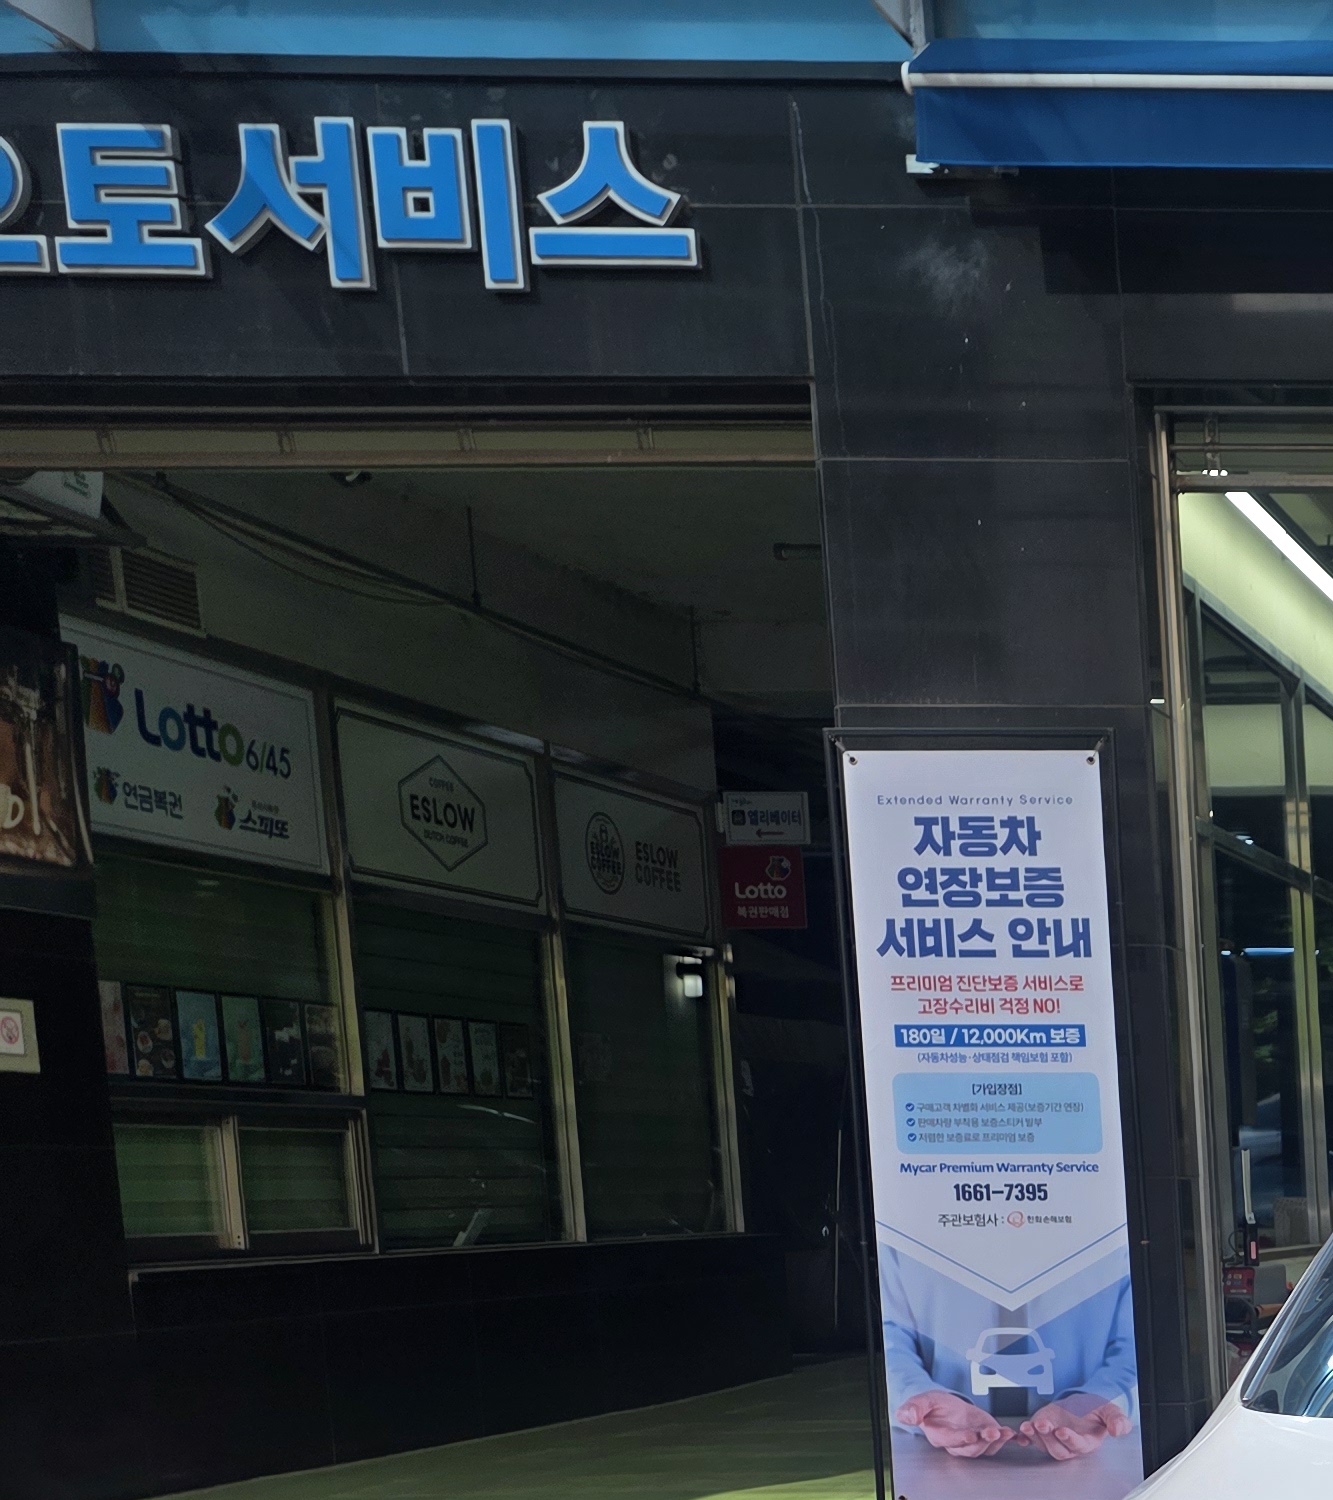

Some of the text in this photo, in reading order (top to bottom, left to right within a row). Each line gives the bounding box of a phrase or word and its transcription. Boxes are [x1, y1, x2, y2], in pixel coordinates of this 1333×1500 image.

[134, 687, 292, 780] Lotto 6/45
[122, 780, 184, 820] 연금복권
[877, 793, 1074, 808] Extended Warranty Service
[410, 793, 475, 833] ESLOW
[747, 809, 802, 827] 엘리베이터
[913, 815, 1042, 858] 자동차
[635, 840, 679, 870] ESLOW
[635, 862, 682, 893] COFFEE
[734, 881, 787, 899] Lotto
[897, 866, 1065, 909] 연장보증
[876, 917, 1093, 959] 서비스 안내
[890, 974, 1084, 993] 프리미엄 진단보증 서비스로
[918, 998, 1061, 1015] 고장수리비 걱정 NO!
[900, 1027, 1081, 1046] 180일 / 12,000Km 보증
[1011, 1051, 1049, 1063] 책임보험
[1050, 1051, 1073, 1063] 포함)
[971, 1082, 1023, 1097] [가입장점]
[916, 1102, 951, 1113] 구매고객
[980, 1102, 1006, 1113] 서비스
[982, 1132, 1016, 1143] 프리미엄
[1017, 1132, 1035, 1143] 보증
[900, 1161, 1099, 1175] Mycar Premium Warranty Service
[953, 1183, 1048, 1202] 1661-7395
[937, 1213, 999, 1227] 주관보험사
